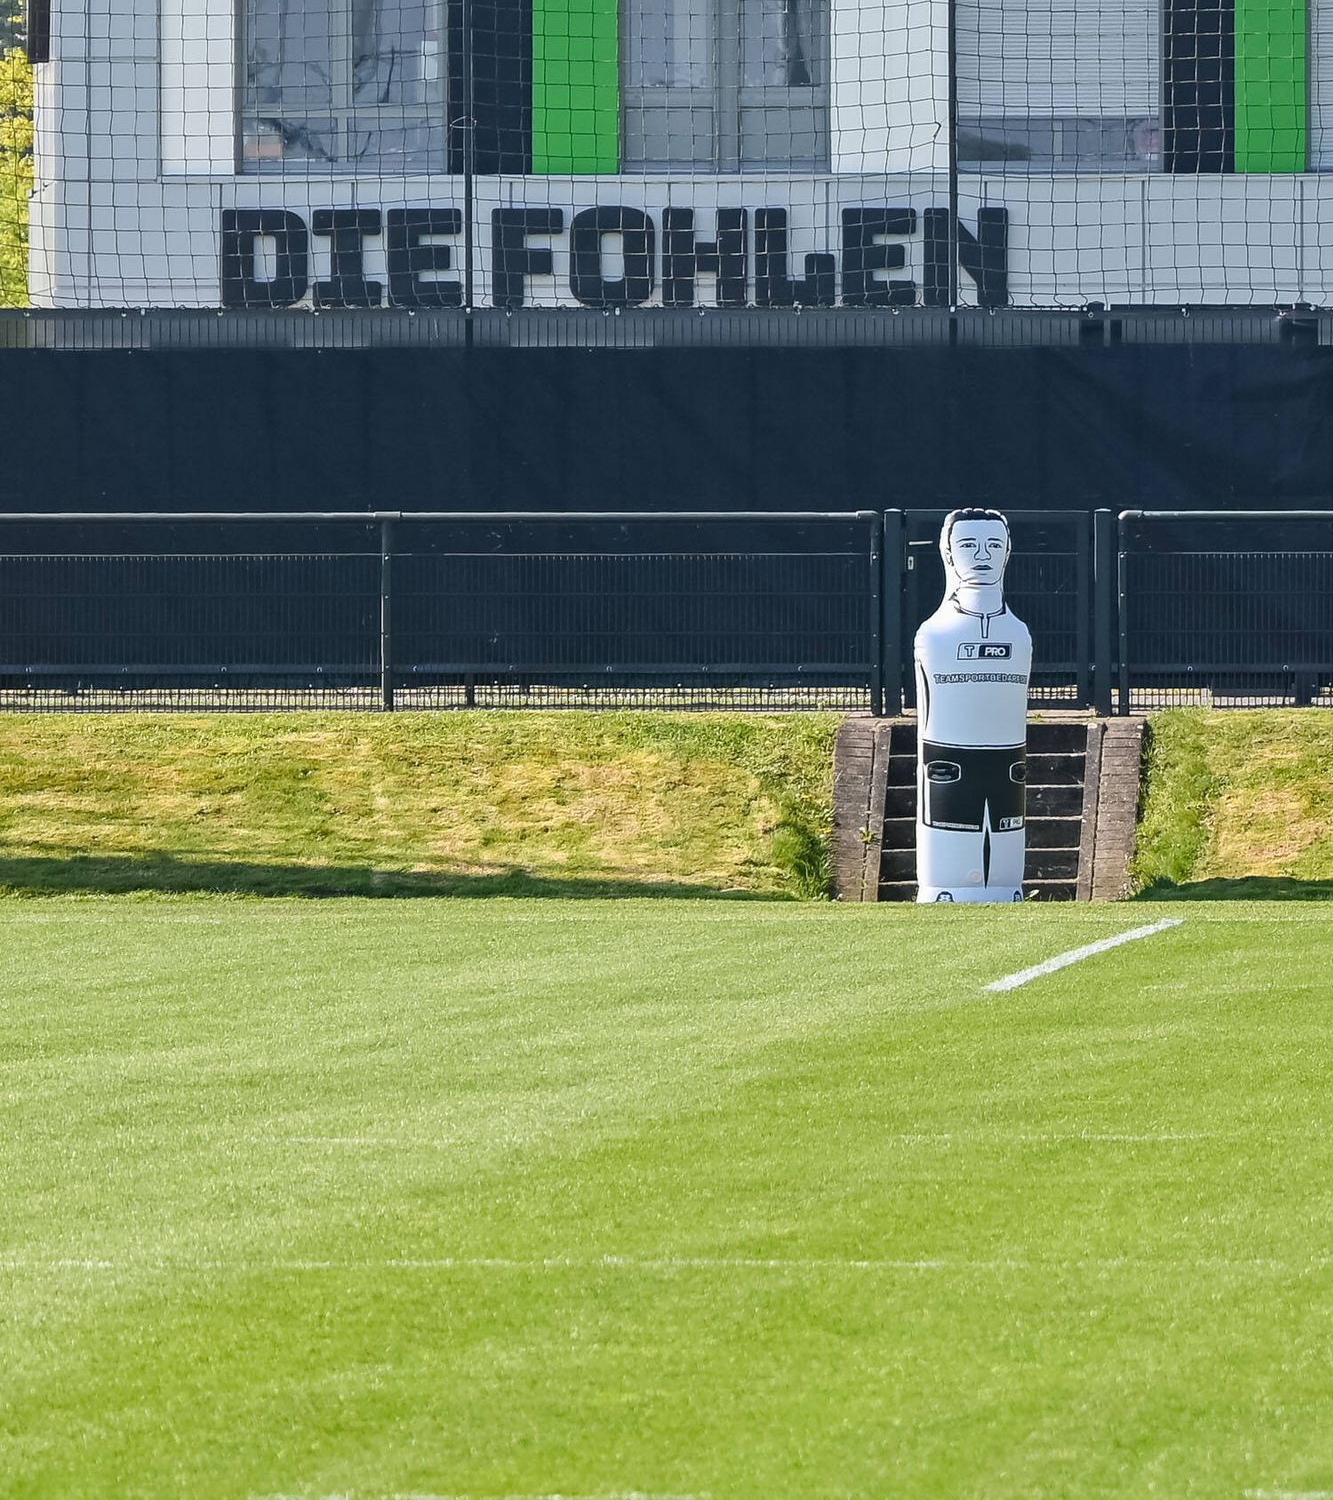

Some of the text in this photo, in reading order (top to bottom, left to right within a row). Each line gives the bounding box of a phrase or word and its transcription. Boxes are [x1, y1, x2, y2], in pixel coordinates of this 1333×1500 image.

[222, 205, 1009, 308] DIE FOHLEN
[984, 646, 1007, 657] PRO
